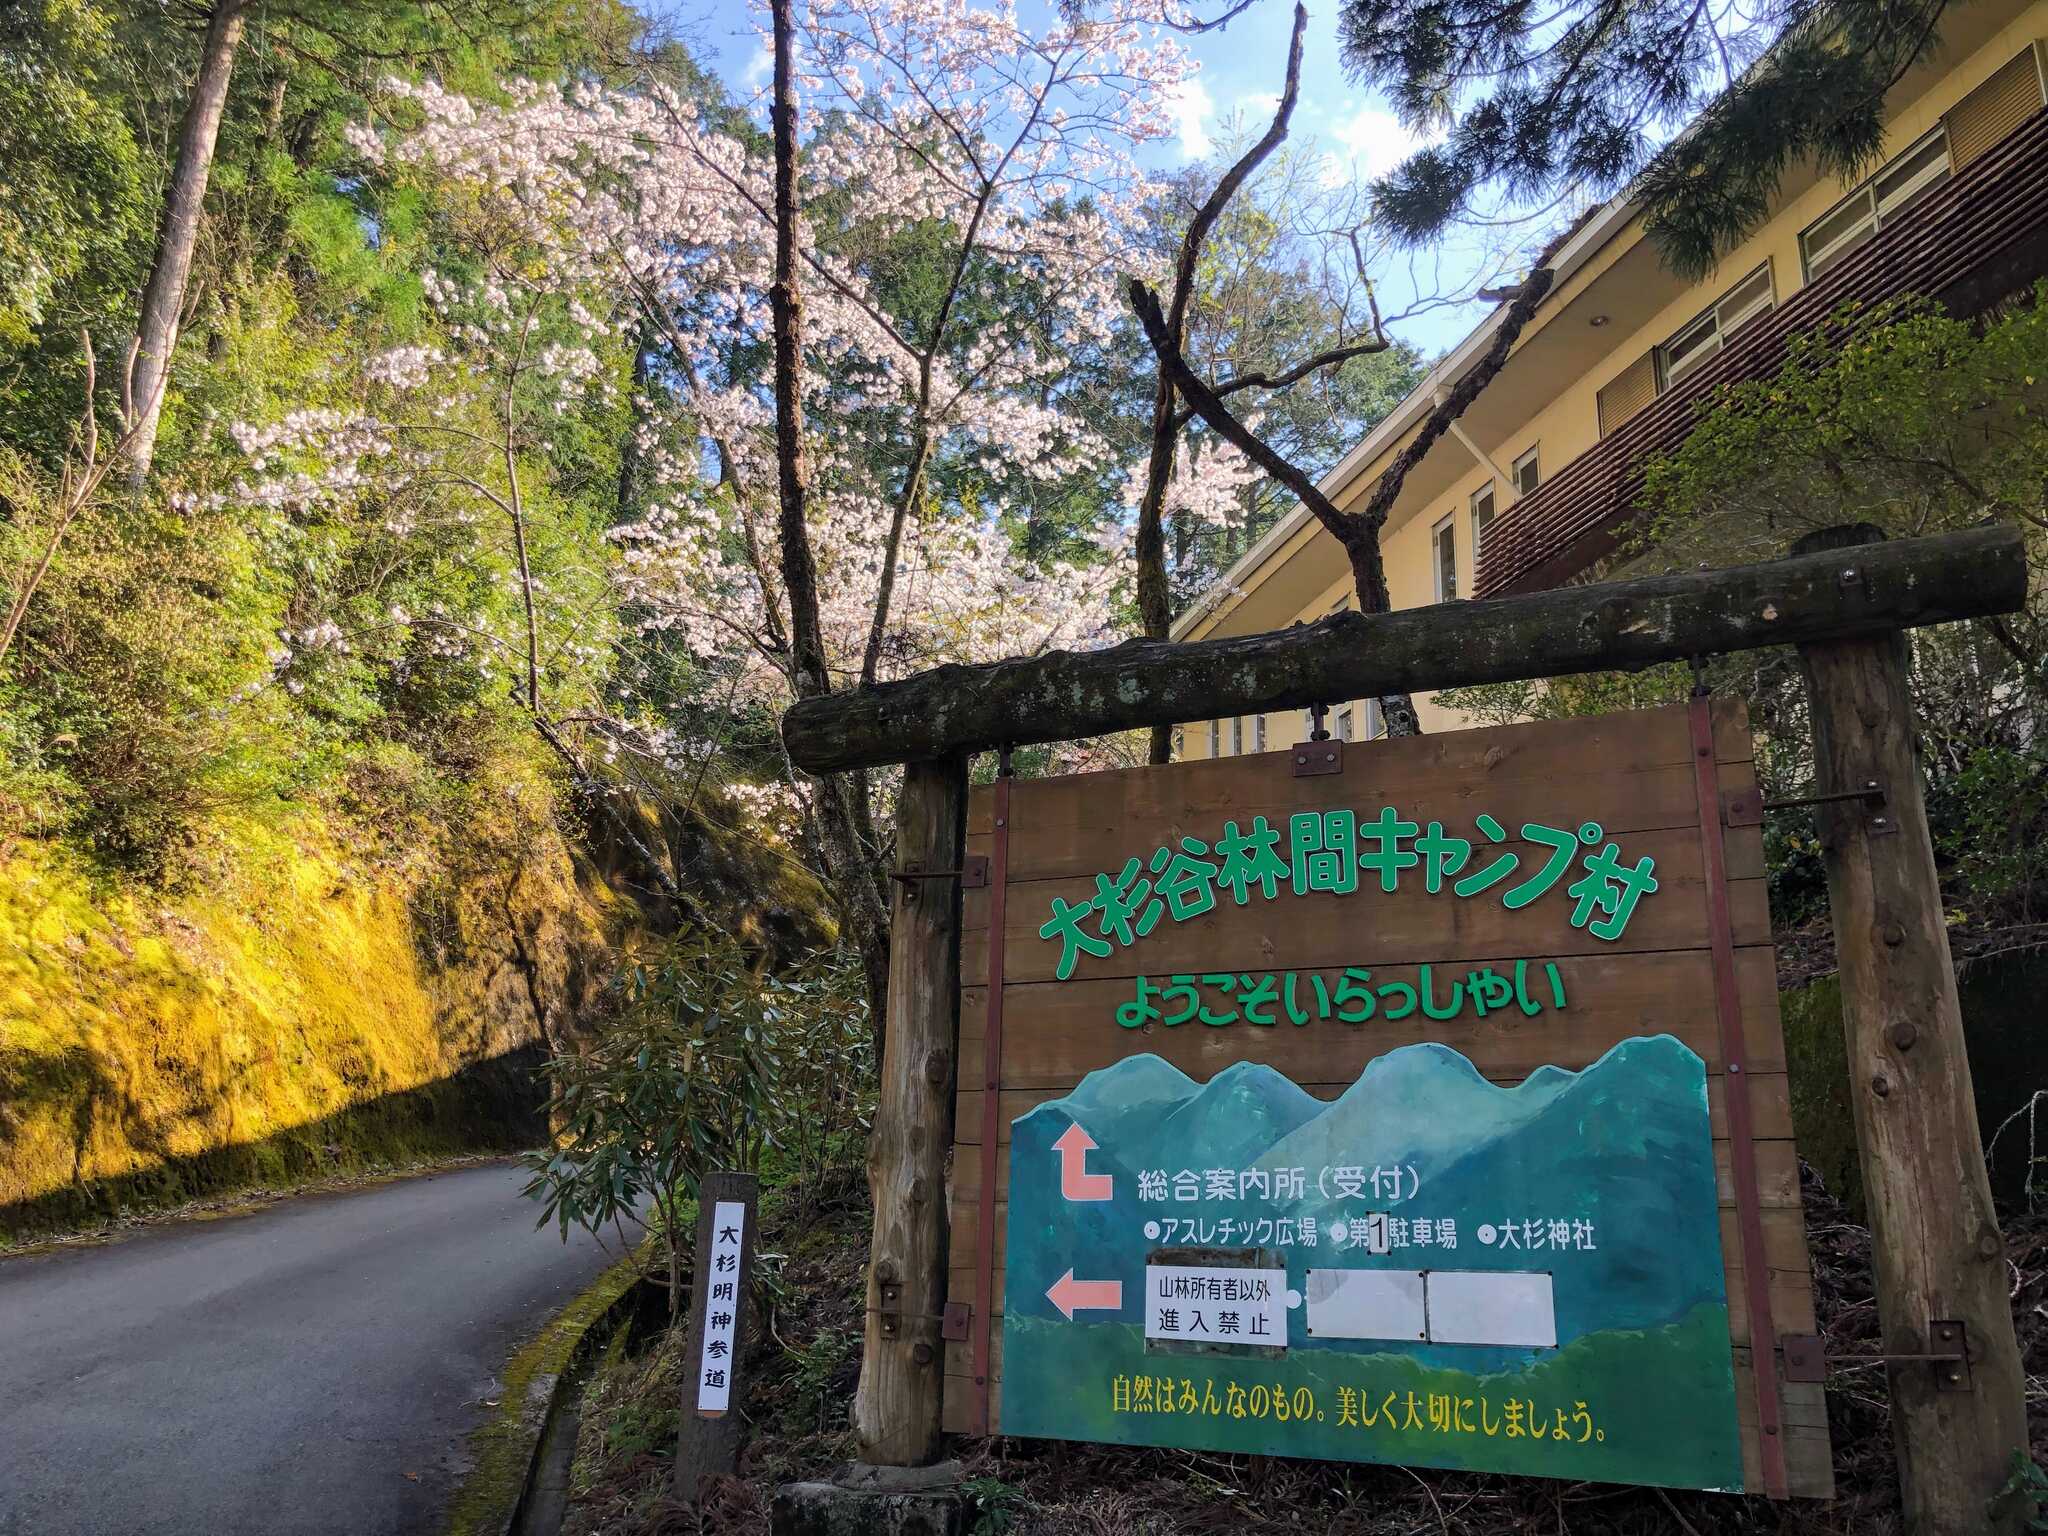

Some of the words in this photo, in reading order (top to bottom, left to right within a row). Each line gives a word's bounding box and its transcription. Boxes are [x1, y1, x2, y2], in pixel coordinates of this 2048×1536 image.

[1039, 806, 1658, 980] 大杉谷林間キャンプ村
[1161, 1217, 1318, 1248] アスレチック広場
[1498, 1217, 1597, 1250] 大杉神社
[1159, 1276, 1271, 1302] 山林所有者以外
[704, 1225, 739, 1388] 大杉明神参道
[1159, 1308, 1271, 1336] 進入禁止
